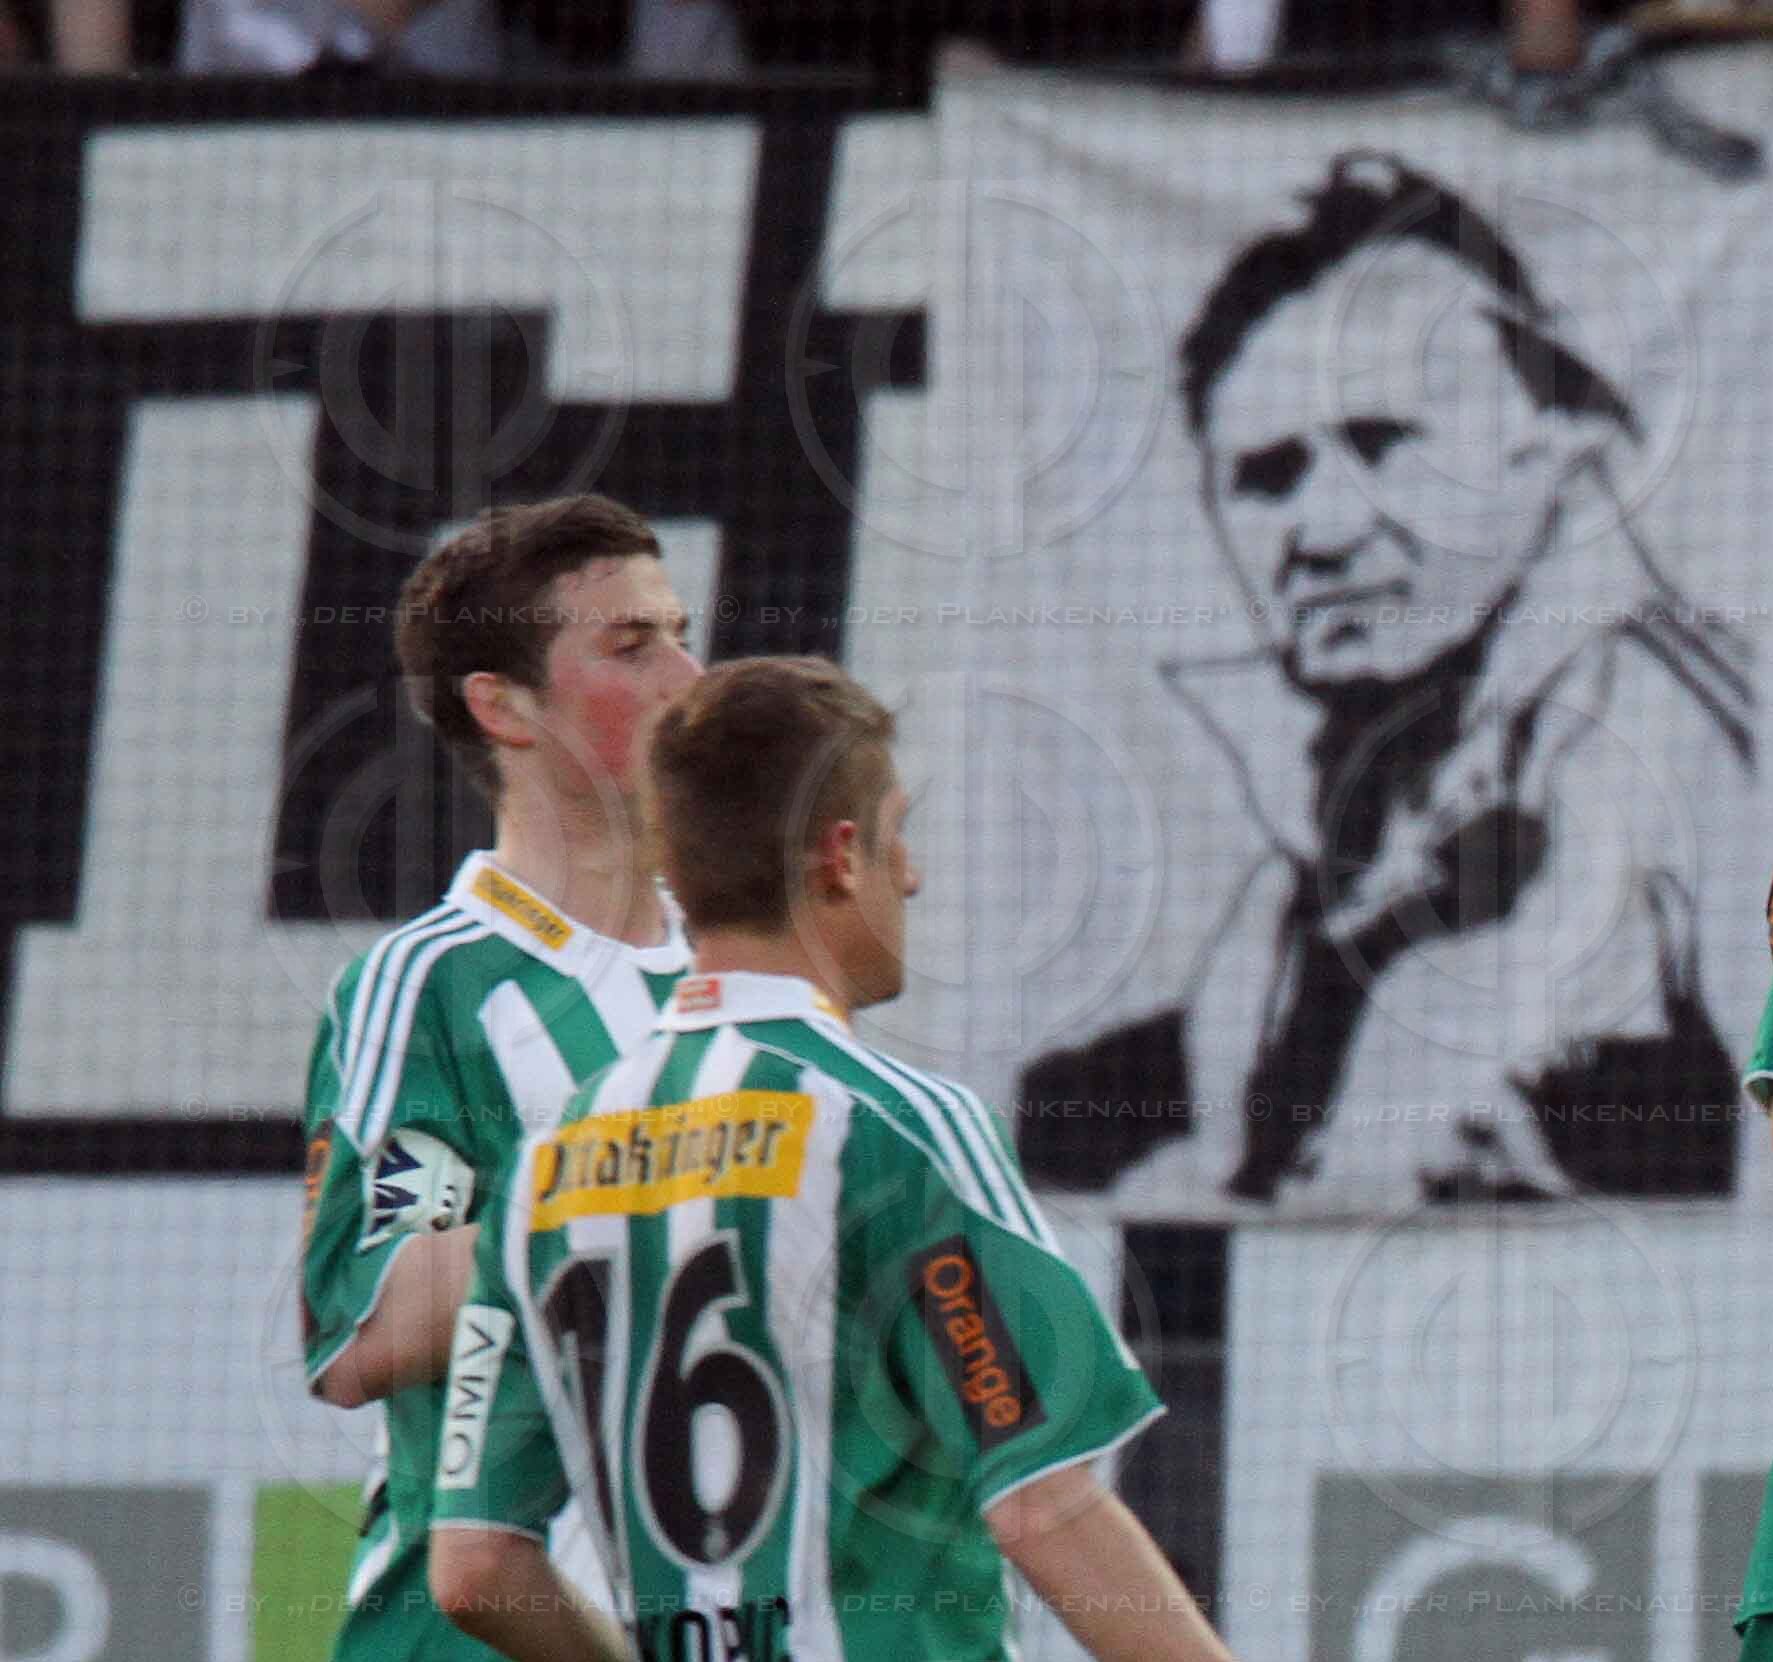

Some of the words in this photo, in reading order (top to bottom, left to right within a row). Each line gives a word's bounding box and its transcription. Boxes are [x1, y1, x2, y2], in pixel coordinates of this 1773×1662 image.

[446, 1321, 496, 1475] OMV
[538, 1228, 798, 1585] 16
[924, 1254, 1023, 1428] Orange
